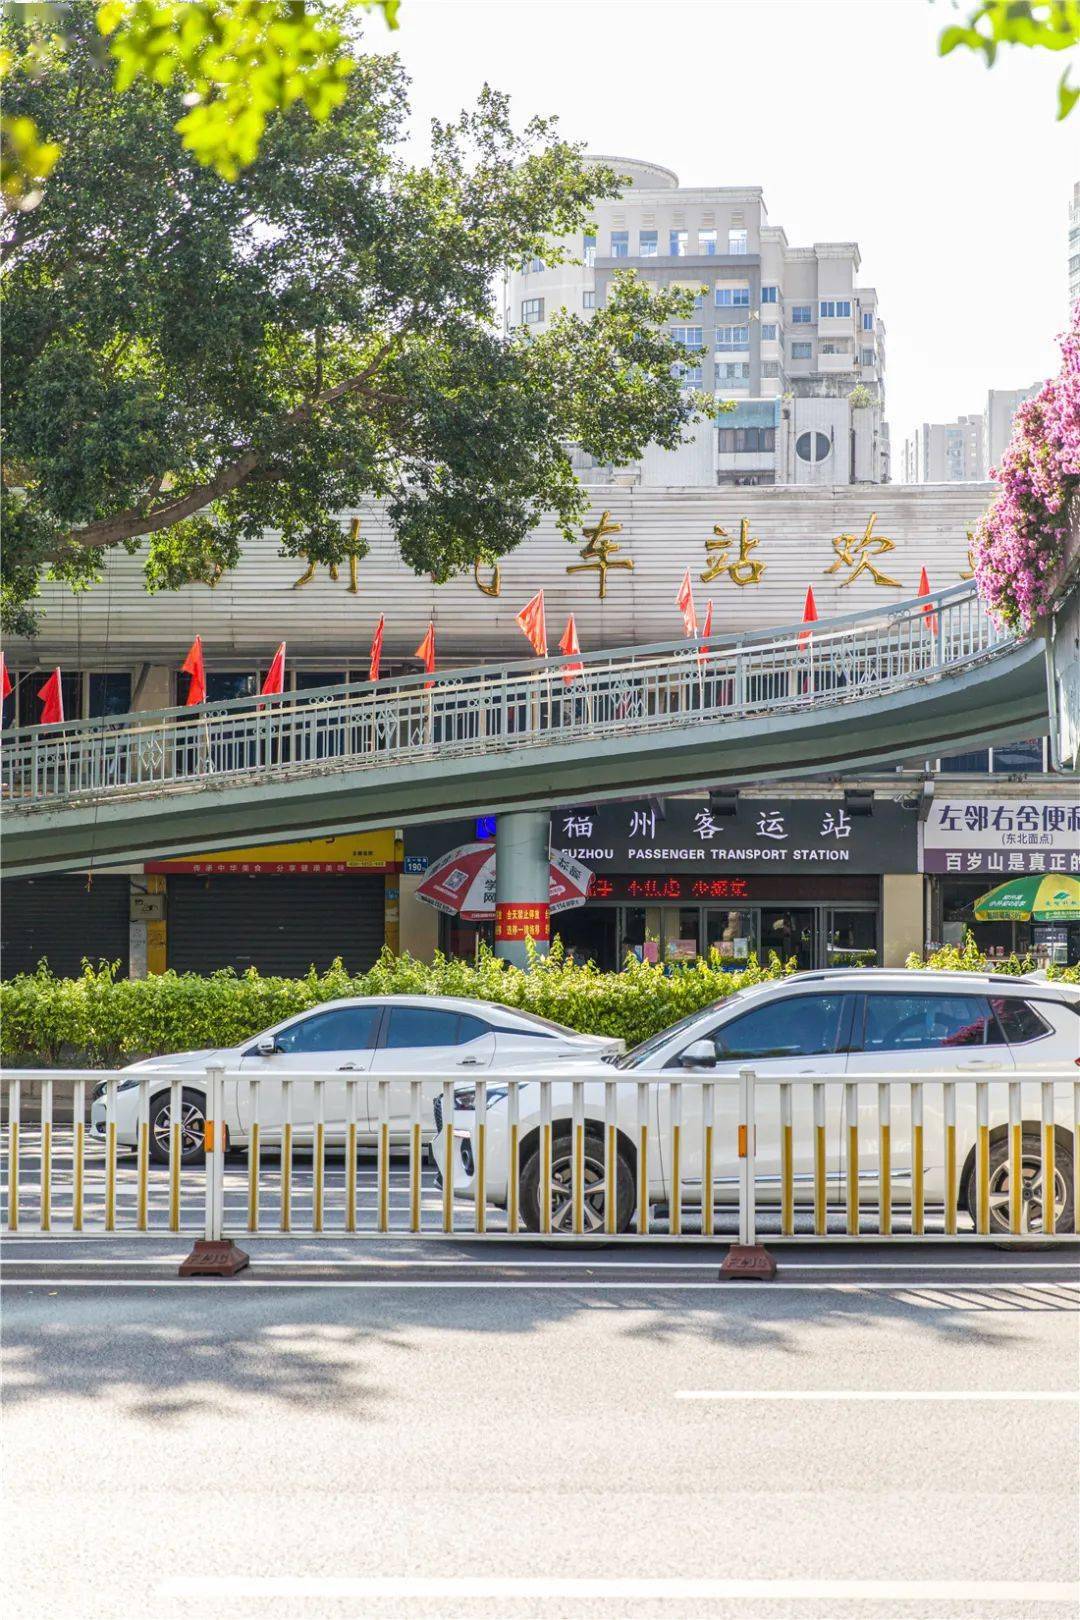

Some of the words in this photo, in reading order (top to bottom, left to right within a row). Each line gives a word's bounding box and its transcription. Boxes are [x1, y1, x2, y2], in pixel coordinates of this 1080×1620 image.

[562, 808, 852, 839] 福州客运站
[1001, 833, 1054, 846] (东北面点)
[628, 848, 706, 860] PASSENGER
[710, 848, 788, 860] TRANSPORT
[792, 848, 850, 860] STATION
